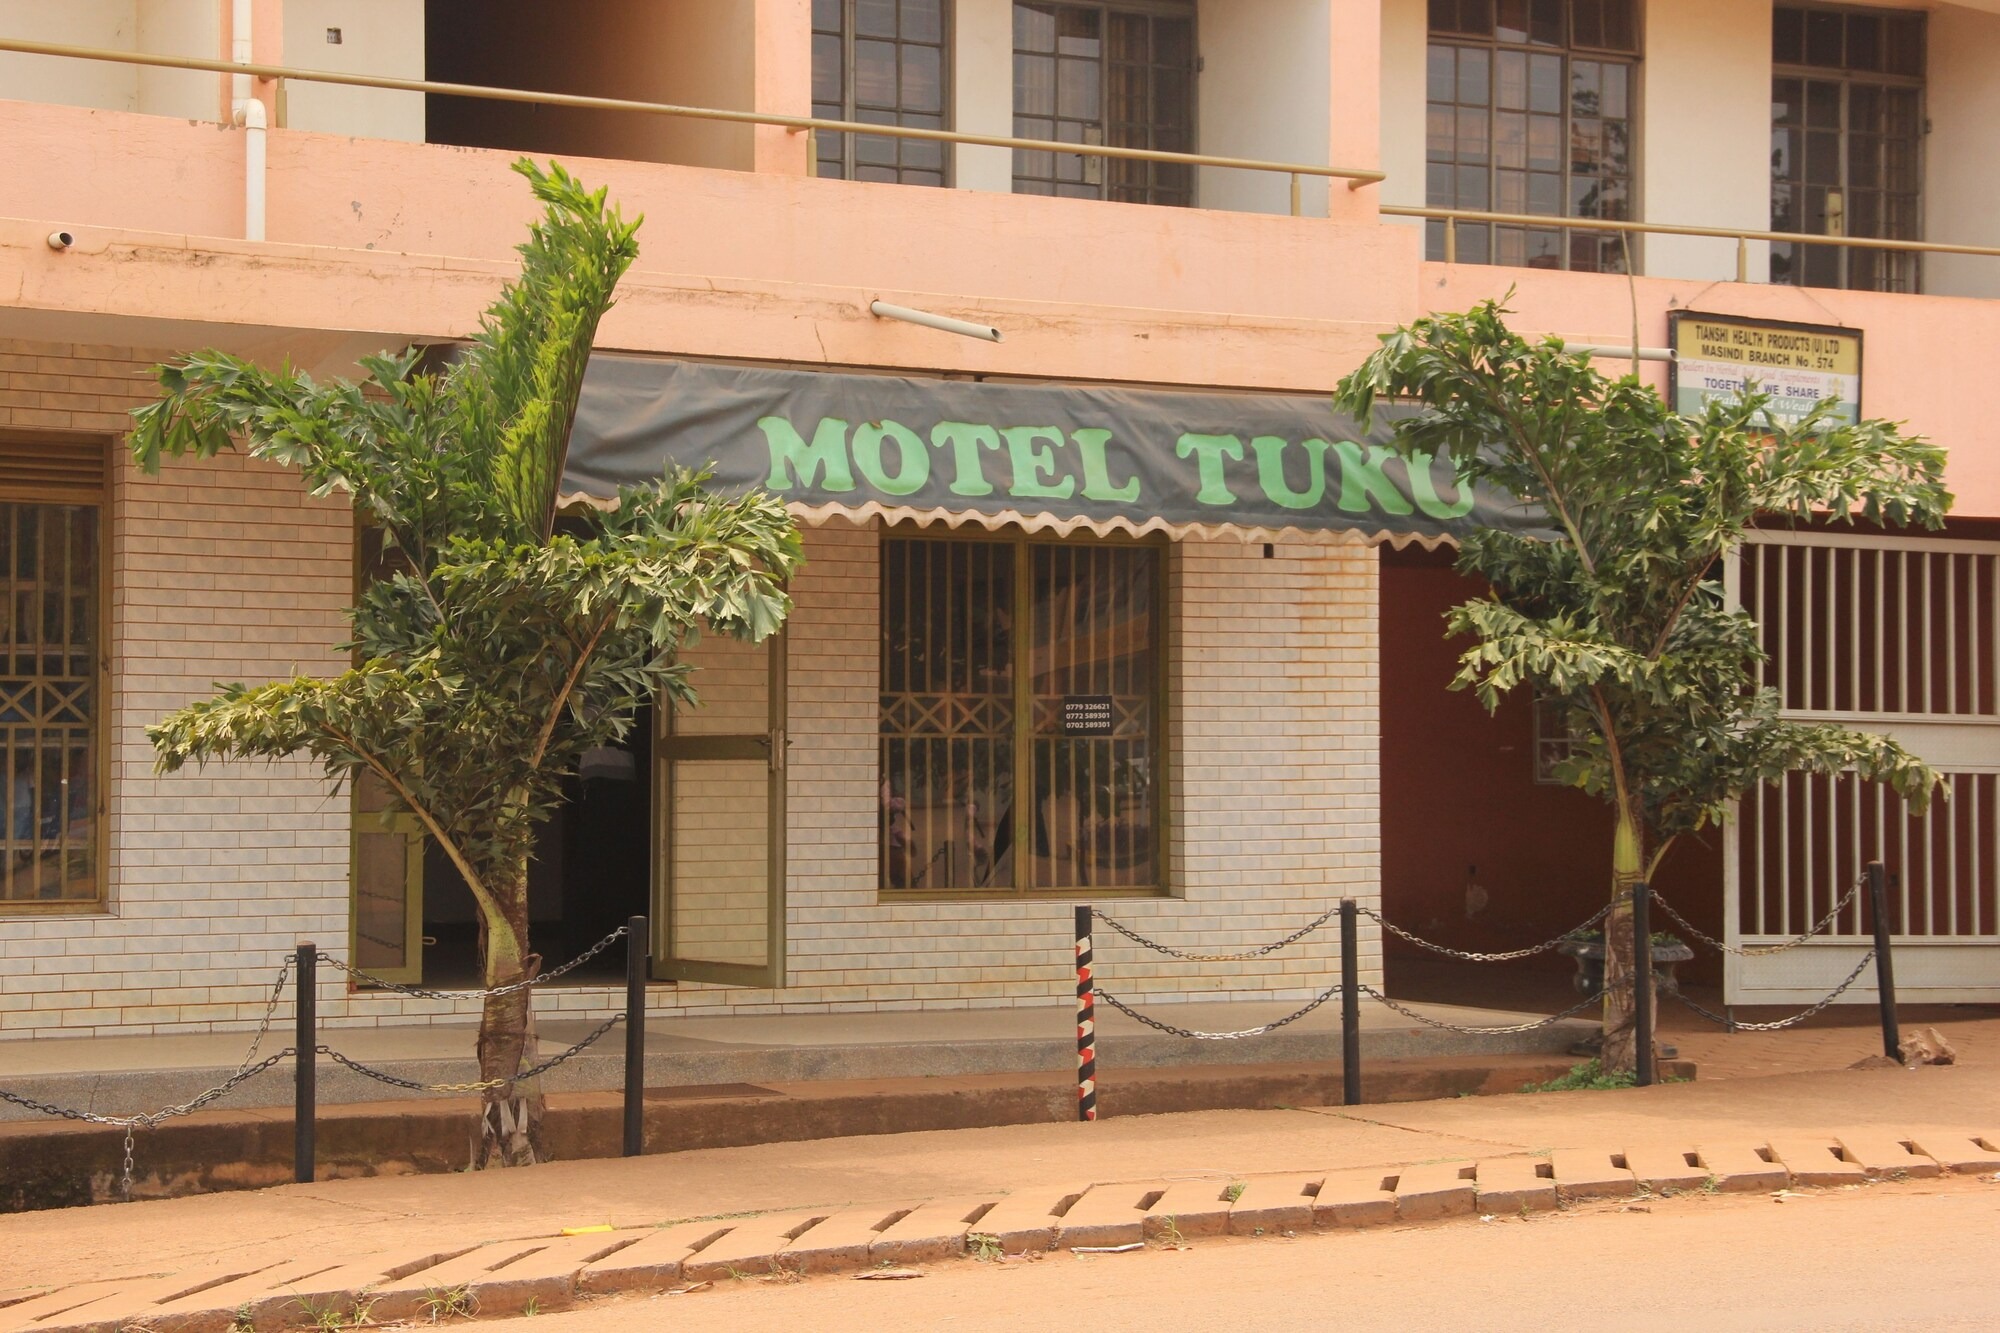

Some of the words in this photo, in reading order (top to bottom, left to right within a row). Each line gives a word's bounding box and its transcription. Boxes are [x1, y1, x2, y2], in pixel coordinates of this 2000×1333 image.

[1695, 325, 1728, 342] TIANSHI
[1732, 330, 1763, 347] HEALTH
[1768, 334, 1810, 352] PRODUCTS
[1811, 339, 1823, 356] (U)
[1824, 339, 1840, 355] LTD
[1701, 344, 1744, 360] MASINDI
[1749, 350, 1790, 366] BRANCH
[1817, 357, 1834, 369] 574
[1763, 384, 1780, 395] WE
[1786, 386, 1819, 399] SHARE
[756, 415, 1141, 503] MOTEL
[1175, 432, 1475, 520] TUKU
